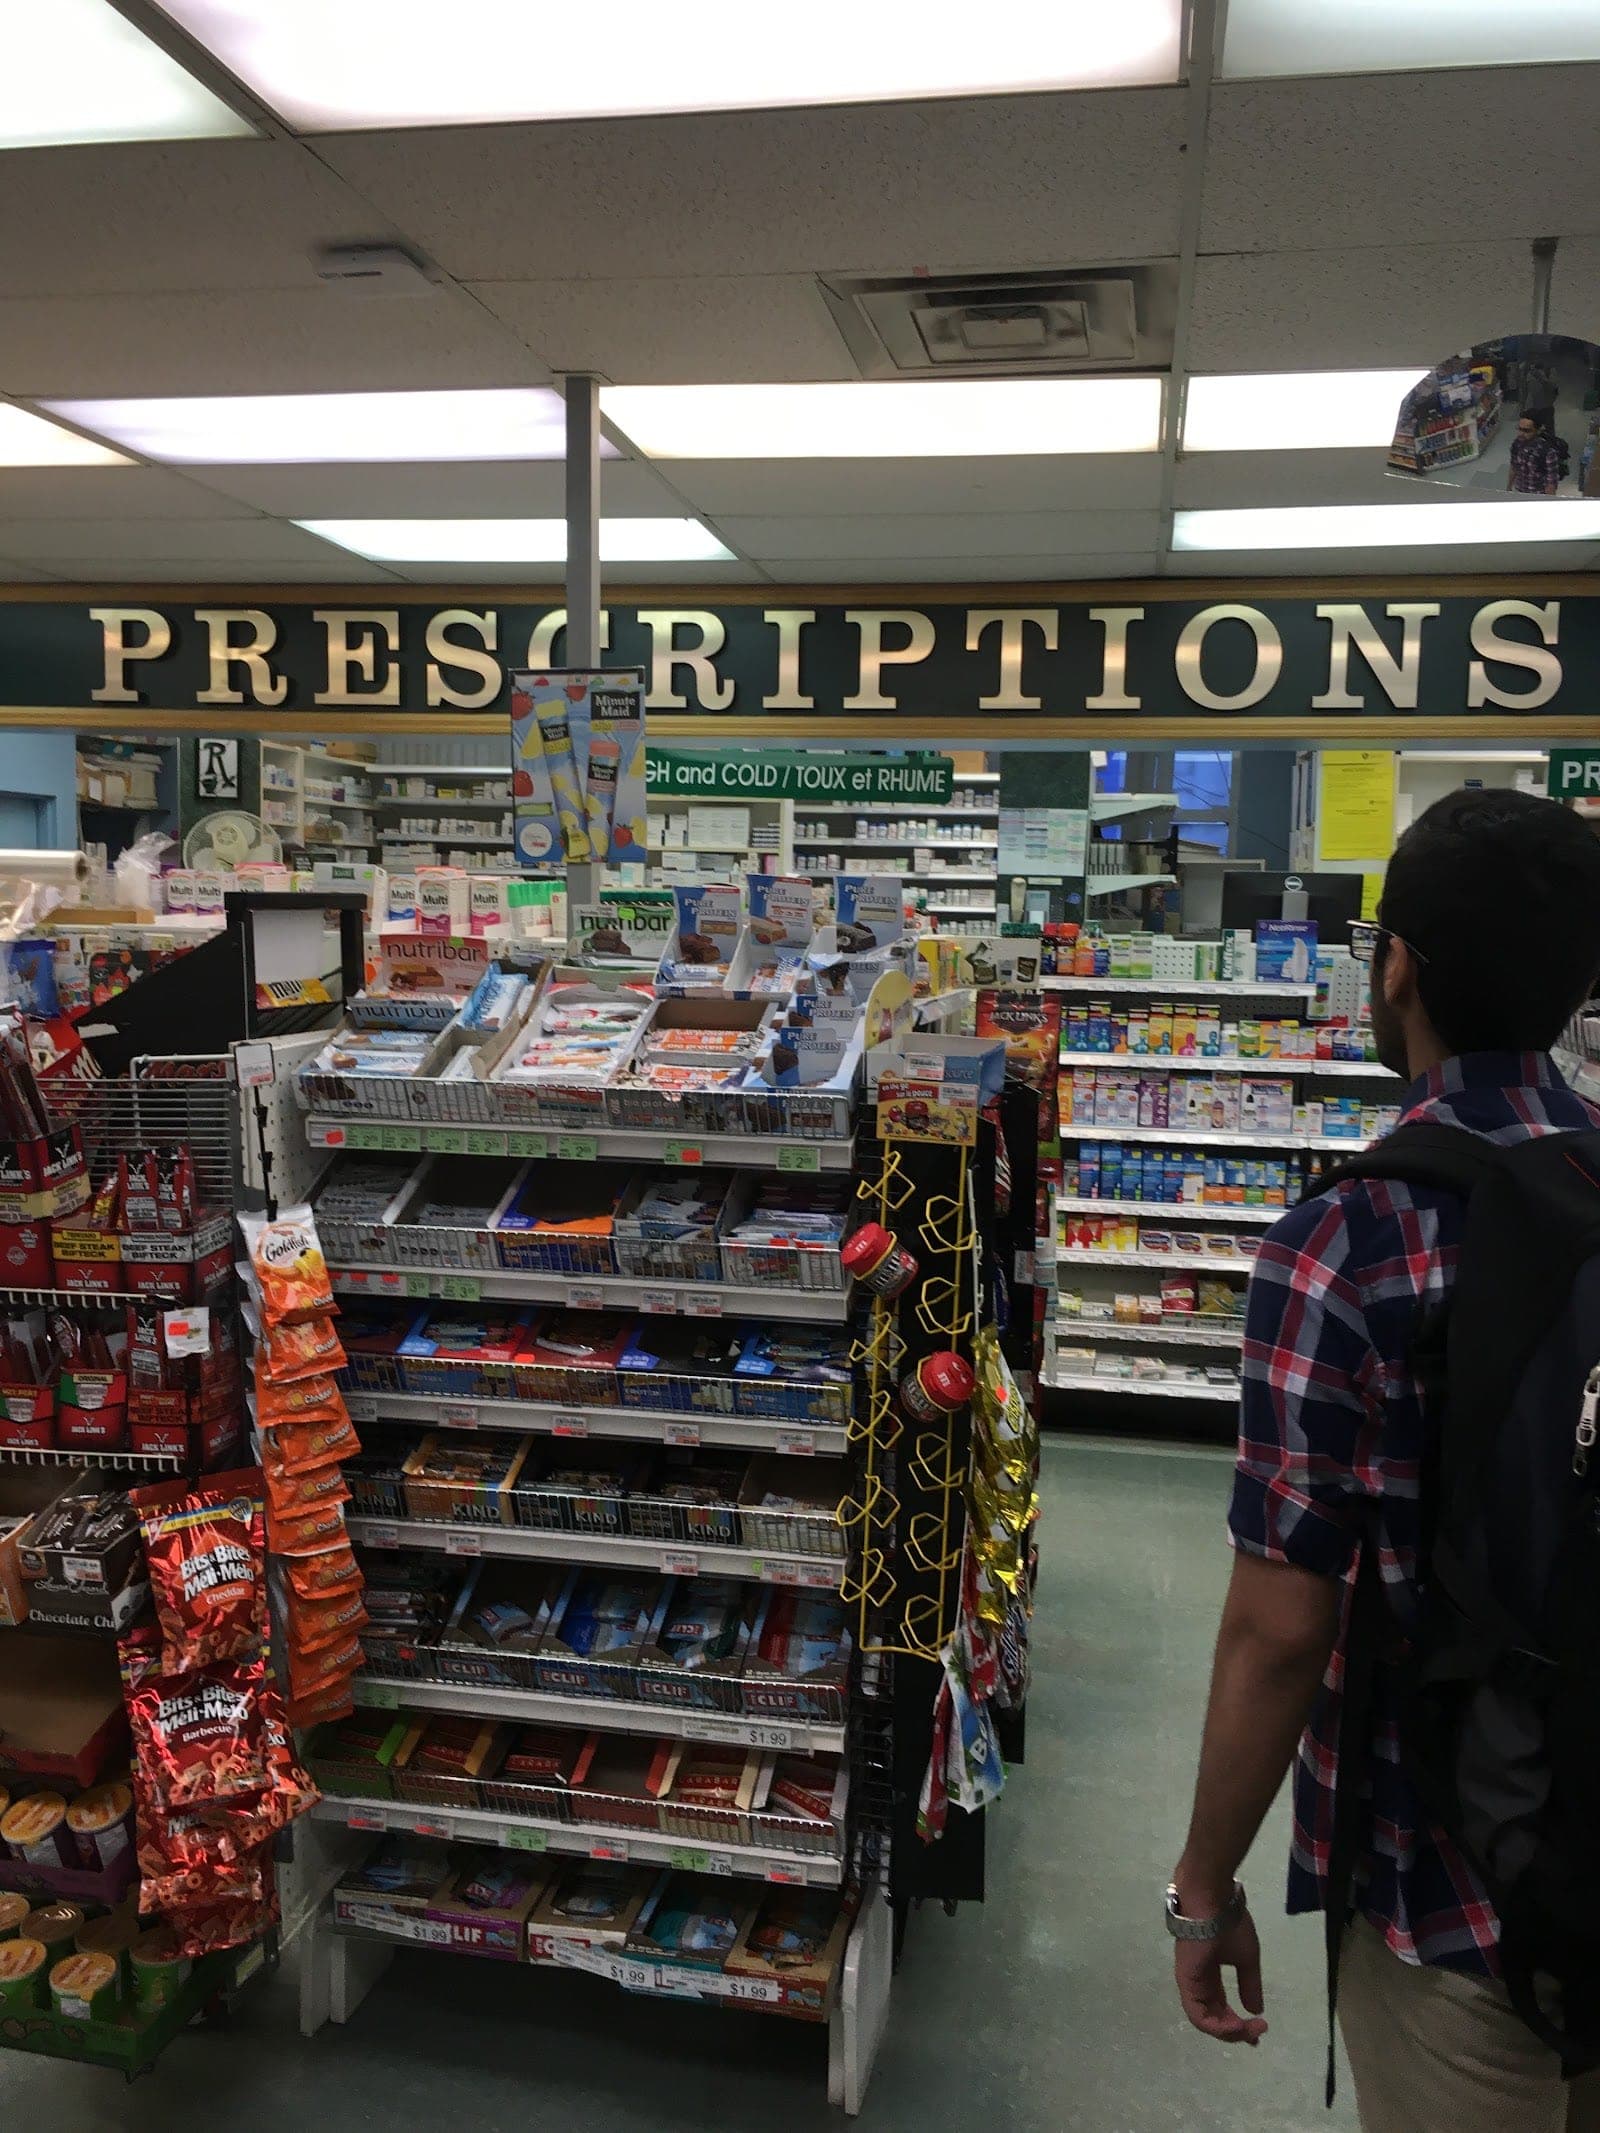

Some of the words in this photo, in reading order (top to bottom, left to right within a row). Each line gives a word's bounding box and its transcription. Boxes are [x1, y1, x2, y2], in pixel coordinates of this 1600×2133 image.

[595, 694, 637, 707] Minute
[600, 705, 631, 717] Maid
[676, 761, 716, 785] and
[721, 762, 778, 788] COLD
[795, 765, 847, 790] TOUX
[852, 768, 873, 791] et
[877, 770, 946, 793] RHUME
[170, 885, 194, 895] Multi
[198, 886, 222, 896] Multi
[390, 889, 416, 900] Multi
[422, 893, 449, 907] Multi
[472, 892, 499, 905] Multi
[387, 940, 482, 962] nutribar
[786, 1031, 818, 1041] PURE
[43, 1158, 63, 1178] JACK
[62, 1150, 83, 1172] LINK'S
[54, 1241, 79, 1251] BEEF
[80, 1242, 115, 1252] STEAK
[61, 1249, 107, 1258] BIFTECK
[122, 1243, 149, 1253] BEEF
[150, 1244, 187, 1253] STEAK
[264, 1233, 311, 1262] Goldfish
[131, 1251, 178, 1260] BIFTECK
[66, 1279, 85, 1288] JACK
[85, 1280, 110, 1289] LINK'S
[137, 1281, 158, 1290] JACK
[158, 1281, 181, 1290] LINK'S
[71, 1426, 88, 1434] JACK
[88, 1426, 107, 1435] LINK'S
[6, 1437, 22, 1445] JACK
[22, 1438, 39, 1447] LINK'S
[141, 1442, 161, 1452] JACK
[160, 1443, 185, 1453] LINK'S
[452, 1502, 500, 1520] KIND
[574, 1510, 619, 1525] KIND
[686, 1523, 731, 1538] KIND
[180, 1553, 211, 1581] Bits
[205, 1587, 246, 1605] Cheddar
[28, 1607, 91, 1627] Chocolate
[653, 1683, 688, 1698] CLIF
[158, 1694, 194, 1719] Bits
[201, 1685, 245, 1704] Bites
[757, 1695, 797, 1708] CLIF
[182, 1725, 234, 1743] Barbecue
[749, 1729, 787, 1746] $1.99
[710, 1863, 733, 1874] 2.09
[412, 1924, 450, 1943] $1.99
[450, 1926, 483, 1944] LIF
[610, 1964, 646, 1984] $1.99
[729, 1982, 768, 1999] $1.99
